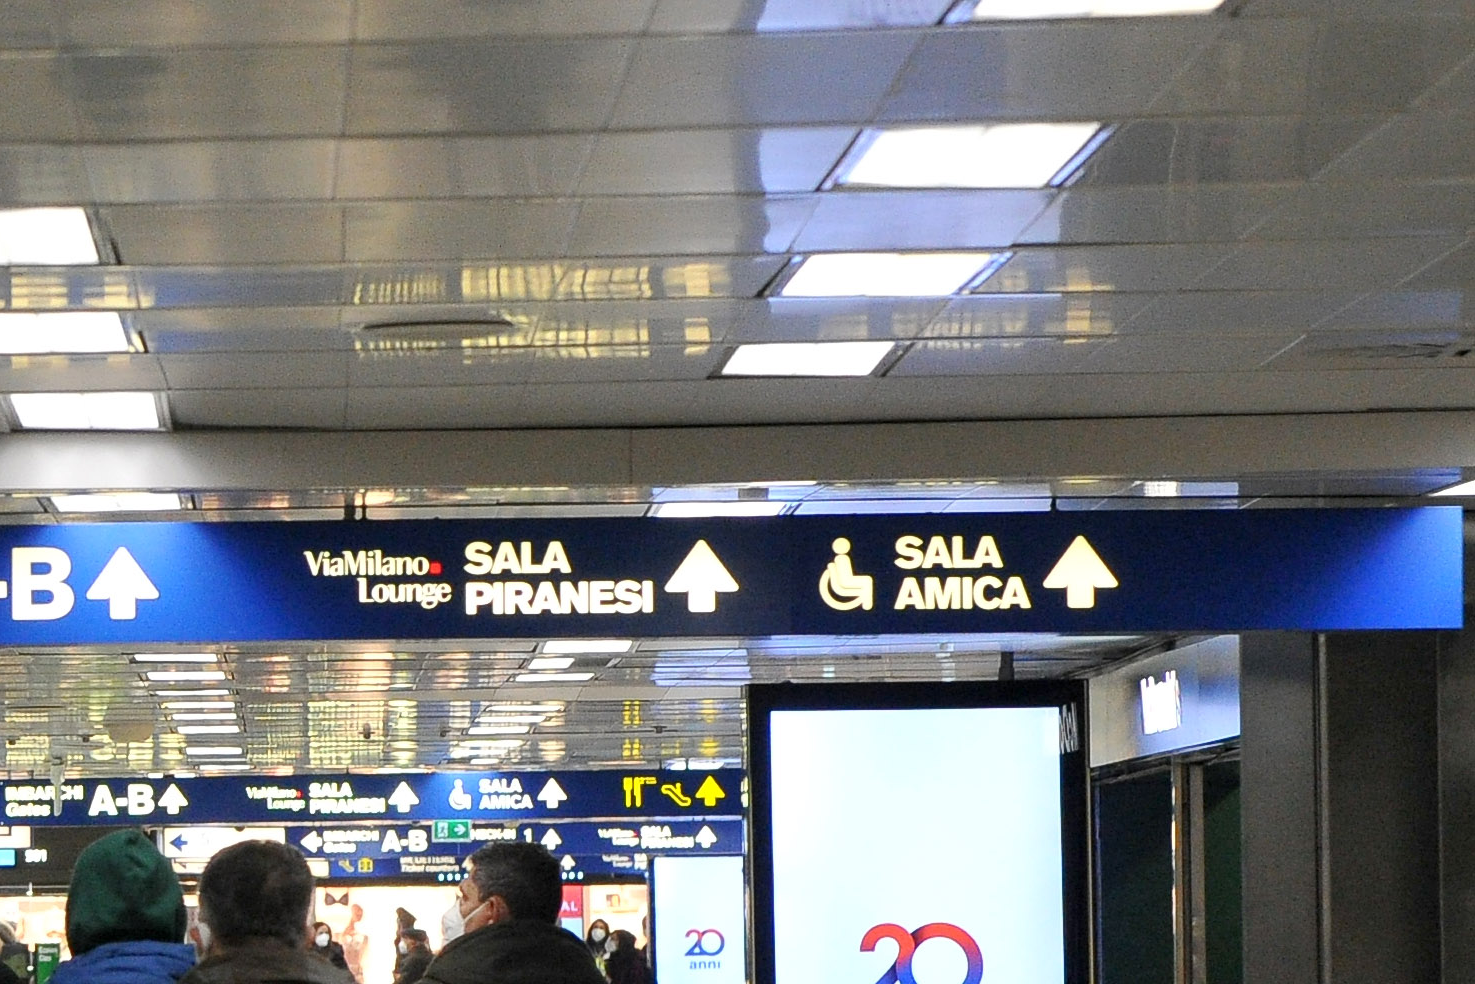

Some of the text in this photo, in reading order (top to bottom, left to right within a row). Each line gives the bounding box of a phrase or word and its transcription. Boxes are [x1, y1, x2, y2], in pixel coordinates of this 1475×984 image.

[303, 549, 429, 577] ViaMilano
[463, 540, 572, 576] SALA
[893, 535, 1004, 570] SALA
[357, 577, 452, 609] Lounge
[465, 579, 654, 616] PIRANESI
[893, 575, 1032, 610] AMICA
[87, 783, 156, 817] A-B
[308, 781, 354, 798] SALA
[478, 778, 523, 794] SALA
[478, 794, 534, 810] AMICA
[381, 829, 428, 853] A-B
[684, 928, 725, 956] 20
